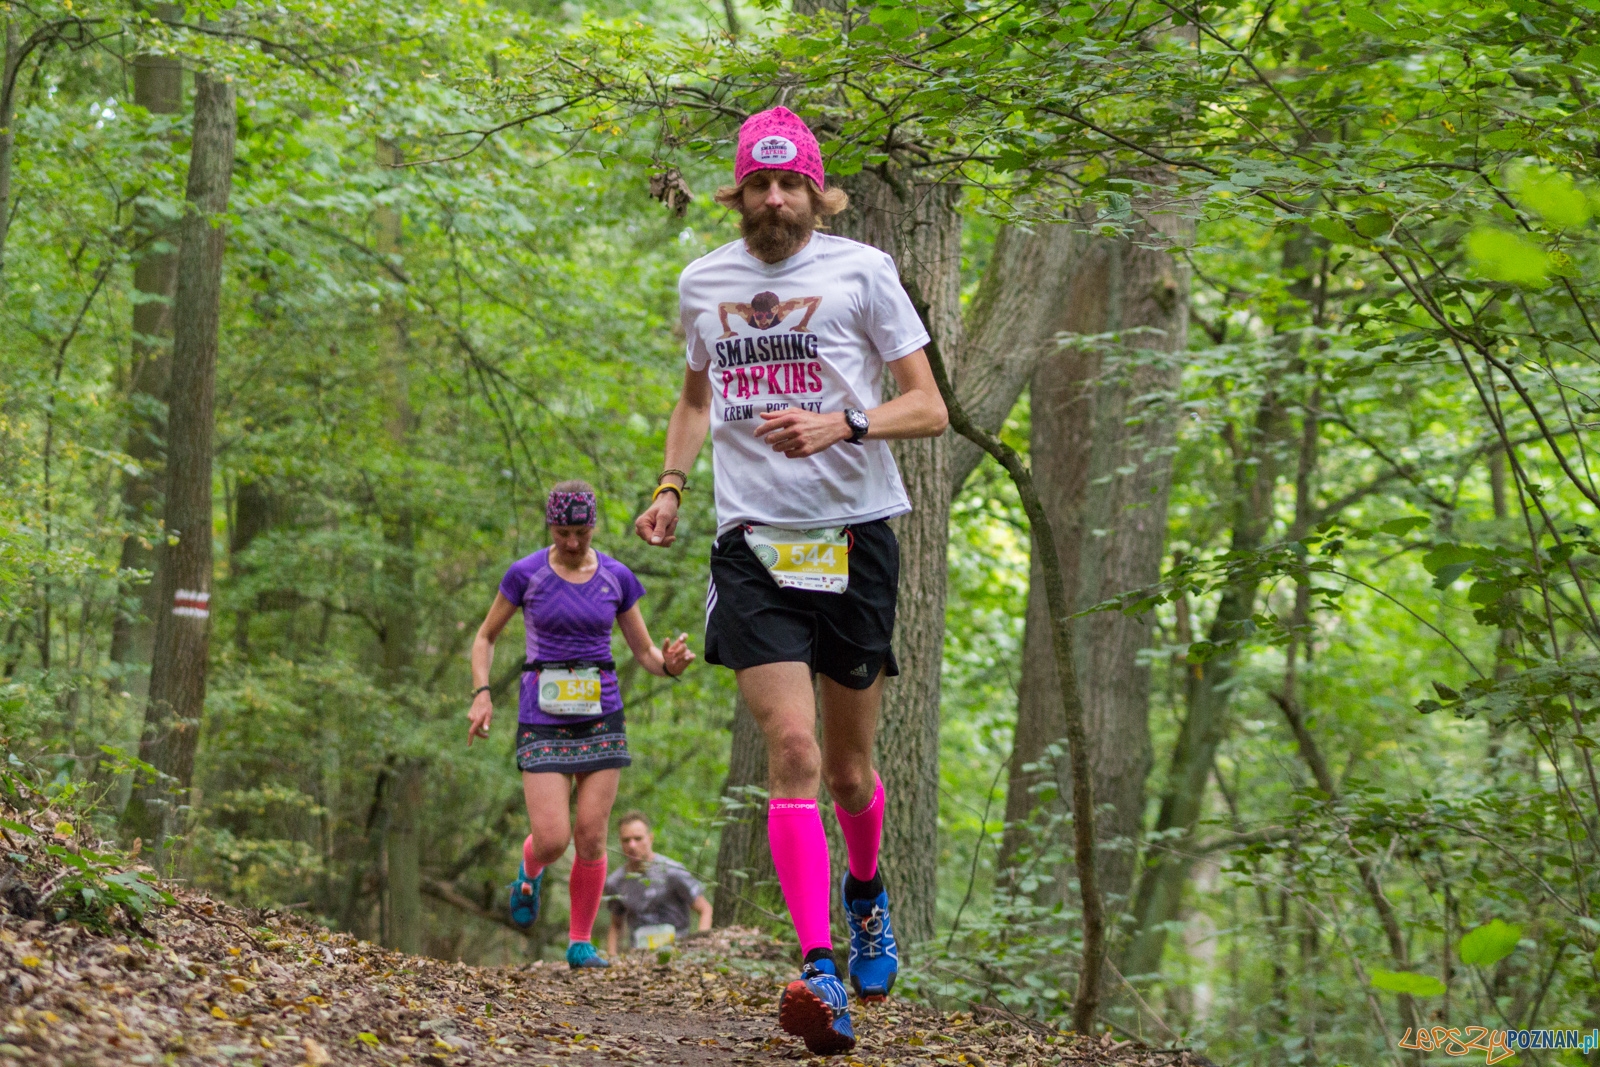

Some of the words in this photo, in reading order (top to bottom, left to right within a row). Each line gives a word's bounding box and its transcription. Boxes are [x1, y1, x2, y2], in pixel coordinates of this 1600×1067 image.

[715, 333, 818, 368] SMASHING
[724, 404, 754, 422] KREW
[790, 545, 836, 567] 544
[567, 681, 595, 697] 545
